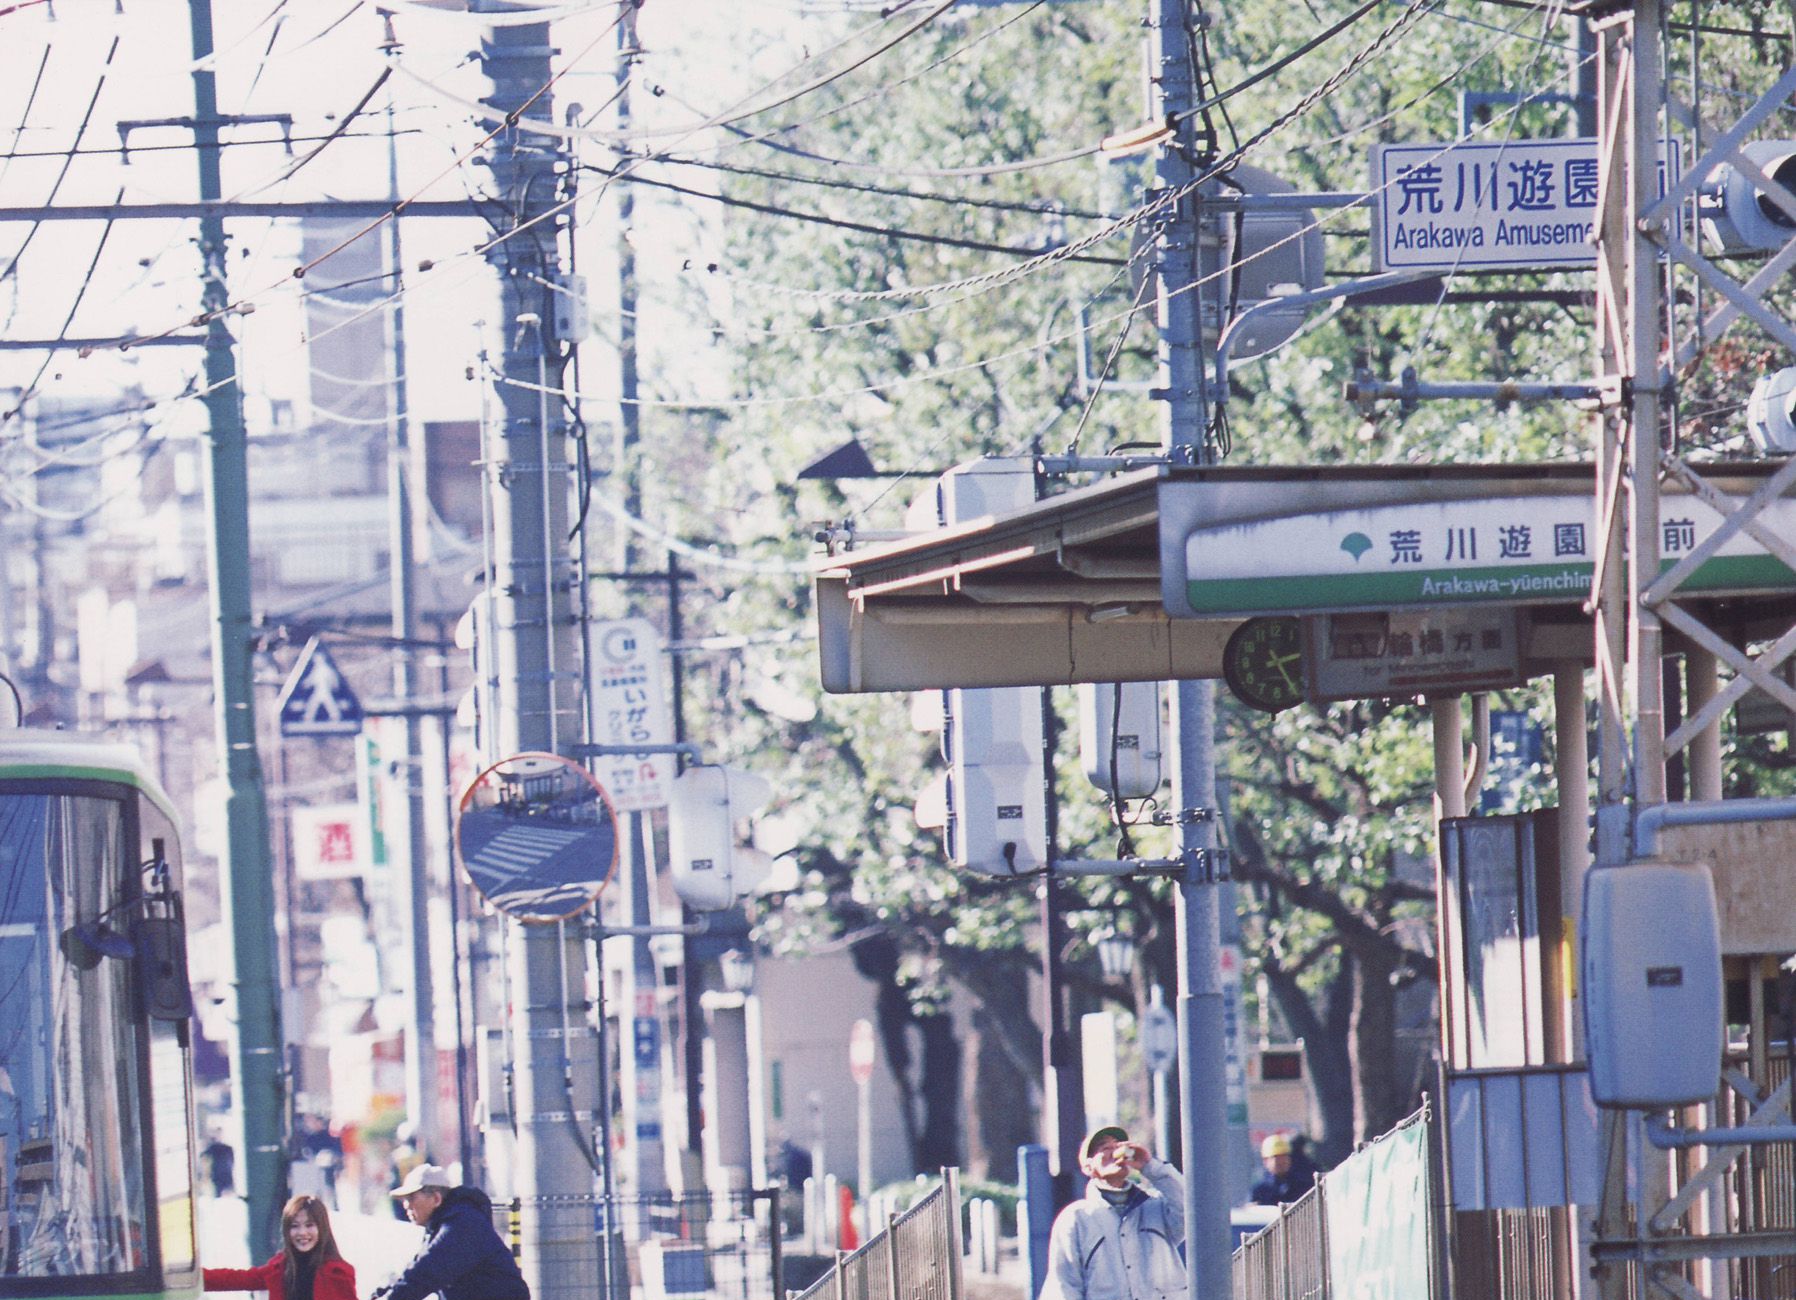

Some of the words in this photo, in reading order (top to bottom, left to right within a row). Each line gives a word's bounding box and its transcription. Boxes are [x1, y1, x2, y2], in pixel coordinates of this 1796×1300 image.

[1396, 159, 1665, 215] 荒川遊園
[1394, 221, 1484, 249] Arakawa
[1389, 518, 1695, 564] 荒川遊園前
